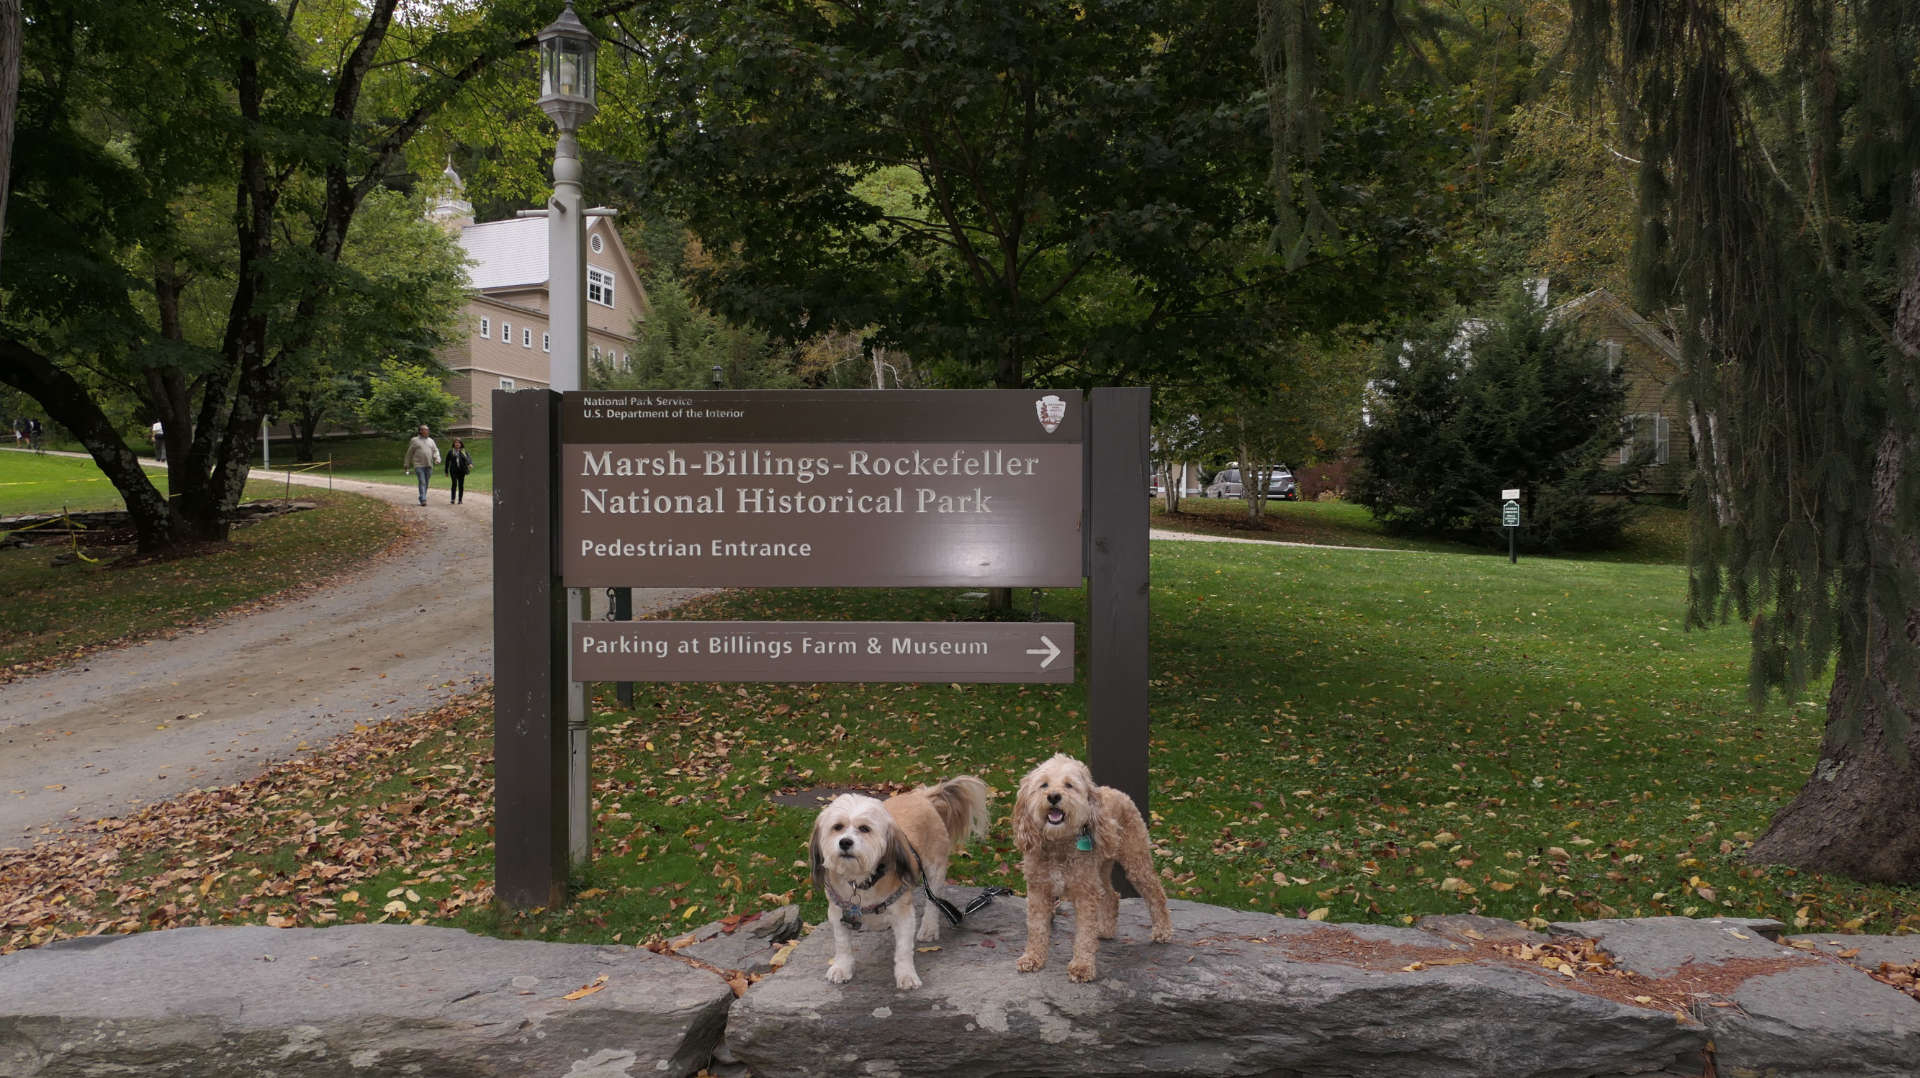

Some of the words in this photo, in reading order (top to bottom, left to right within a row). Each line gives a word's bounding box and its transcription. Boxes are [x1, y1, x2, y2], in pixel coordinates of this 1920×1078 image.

[583, 396, 628, 406] National
[630, 396, 653, 406] Park
[656, 396, 693, 406] Service
[583, 408, 604, 419] U.S.
[606, 408, 670, 421] Department
[671, 408, 683, 418] of
[686, 408, 703, 418] the
[705, 408, 745, 418] Interior
[580, 448, 1040, 484] Marsh-Billings-Rockefeller
[580, 487, 726, 514] National
[736, 487, 905, 514] Historical
[915, 488, 993, 514] Park
[580, 538, 702, 557] Pedestrian
[711, 539, 812, 557] Entrance
[582, 635, 668, 659] Parking
[677, 637, 700, 655] at
[709, 635, 793, 659] Billings
[802, 637, 857, 655] Farm
[866, 637, 882, 655] &
[892, 637, 989, 655] Museum
